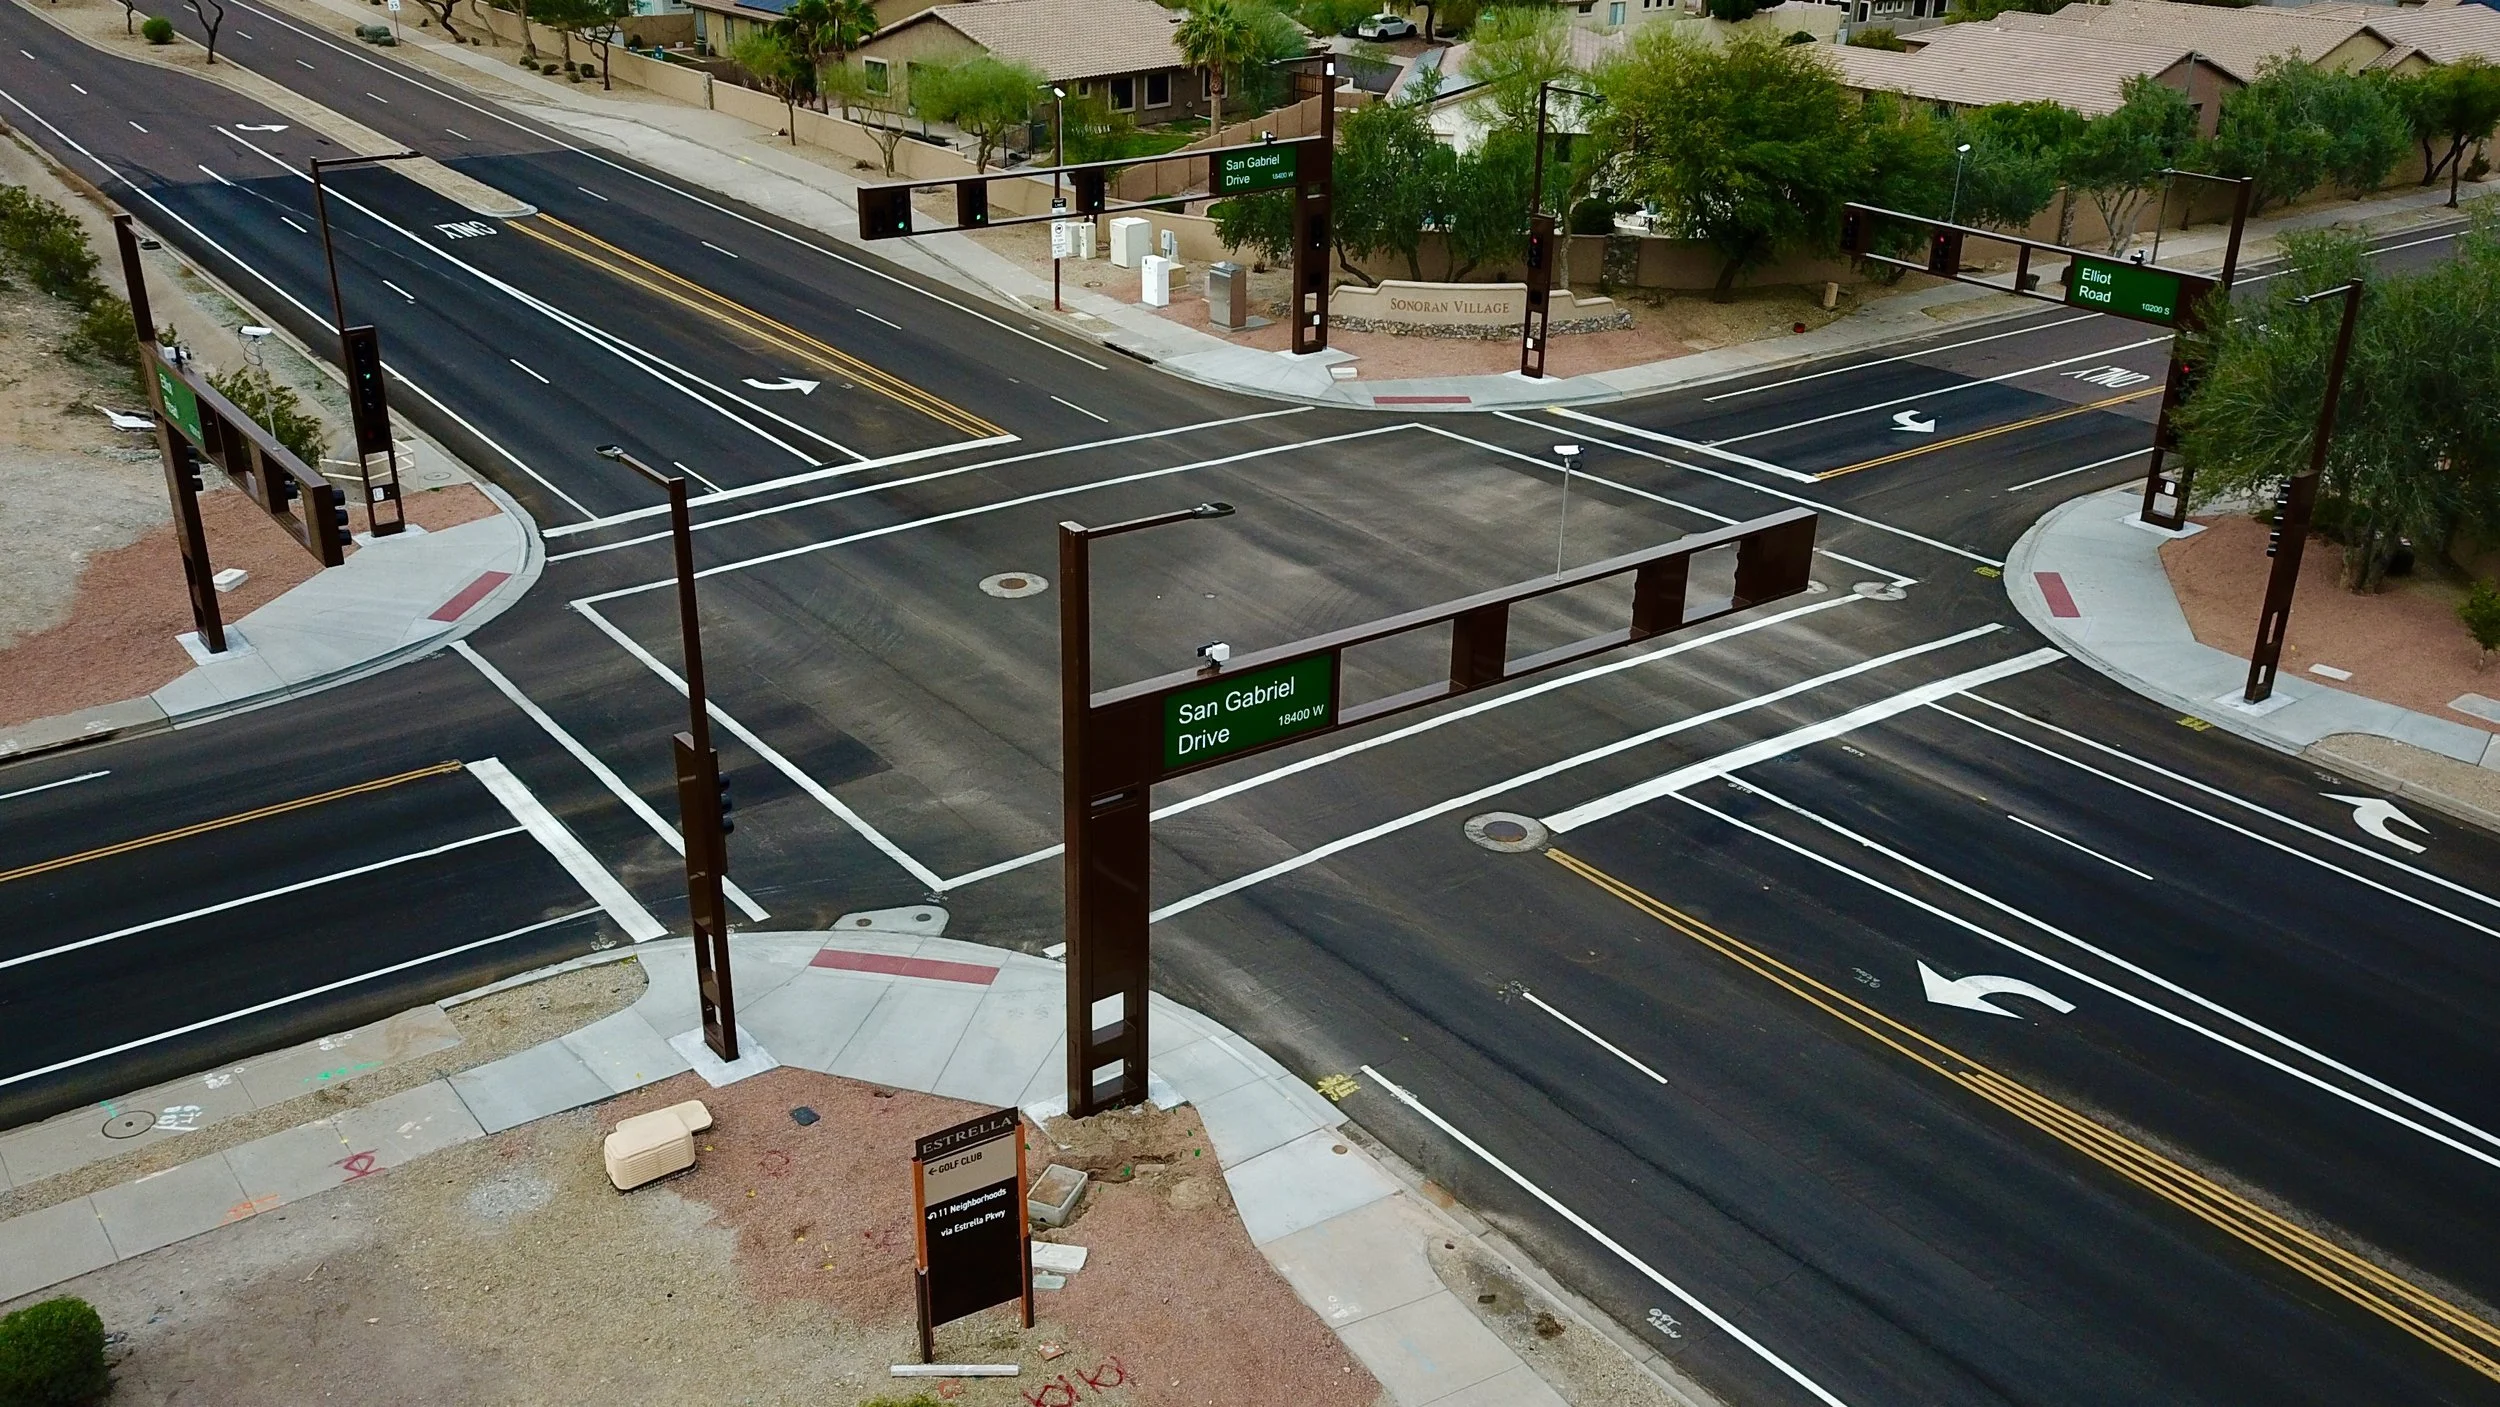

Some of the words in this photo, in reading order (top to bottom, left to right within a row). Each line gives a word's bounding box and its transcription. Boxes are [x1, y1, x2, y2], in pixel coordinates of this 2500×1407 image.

[1226, 160, 1245, 171] San
[1247, 154, 1280, 168] Gabriel
[1226, 174, 1250, 186] Drive
[2081, 267, 2112, 285] Elliot
[2079, 285, 2112, 303] Road
[1390, 298, 1449, 313] SONORAN
[1454, 301, 1510, 314] VILLAGE
[2142, 303, 2163, 314] 10200
[2164, 307, 2170, 315] S
[1178, 701, 1218, 724] San
[1225, 676, 1295, 712] Gabriel
[1278, 708, 1310, 726] 18400
[1312, 704, 1325, 717] W
[1178, 727, 1230, 755] Drive
[922, 1116, 1012, 1154] ESTRELLA
[938, 1159, 960, 1174] GOLF
[960, 1152, 983, 1166] CLUB
[938, 1207, 948, 1217] 11
[950, 1188, 1007, 1214] Neighborhoods
[940, 1227, 953, 1237] via
[954, 1217, 984, 1233] Estrella
[984, 1209, 1006, 1223] Pkwy
